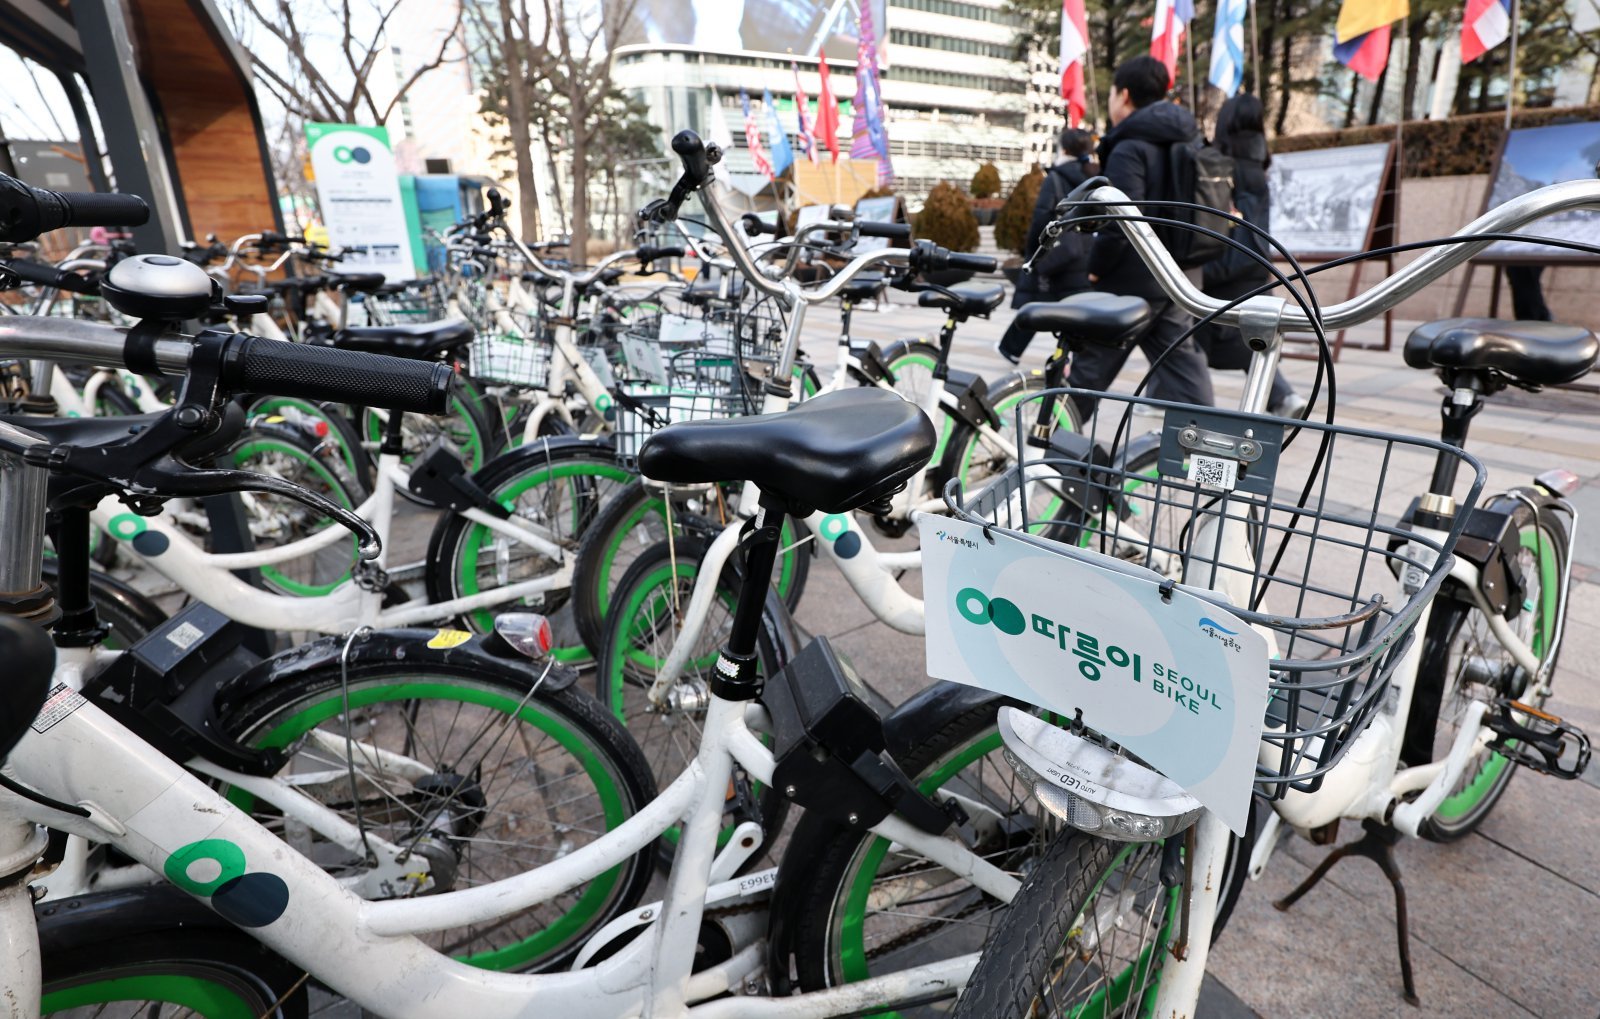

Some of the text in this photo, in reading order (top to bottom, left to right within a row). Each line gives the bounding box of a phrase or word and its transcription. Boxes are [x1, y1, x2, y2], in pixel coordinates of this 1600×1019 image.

[946, 534, 979, 550] 서울특별시
[1031, 613, 1141, 682] 따릉이
[1201, 627, 1242, 653] 서울시설공단
[1152, 662, 1223, 711] SEOUL
[1153, 679, 1200, 715] BIKE
[1046, 767, 1096, 795] AUTO LED LIGHT
